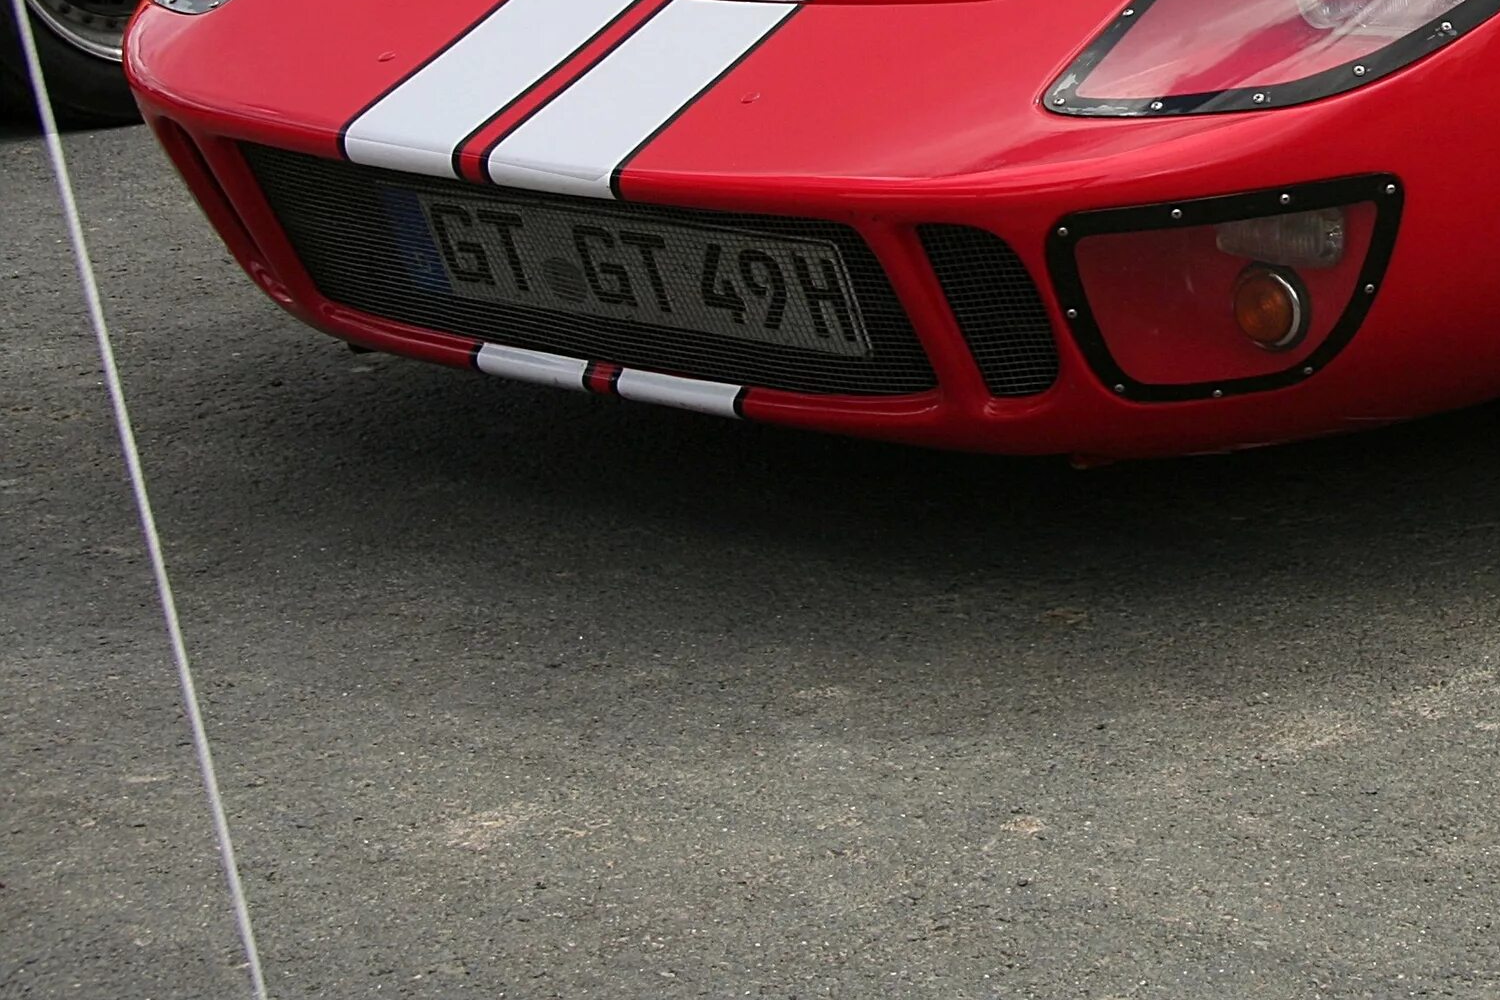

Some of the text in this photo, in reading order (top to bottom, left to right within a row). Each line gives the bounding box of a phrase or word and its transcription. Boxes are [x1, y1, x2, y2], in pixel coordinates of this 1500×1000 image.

[429, 202, 857, 344] GT GT 49H
